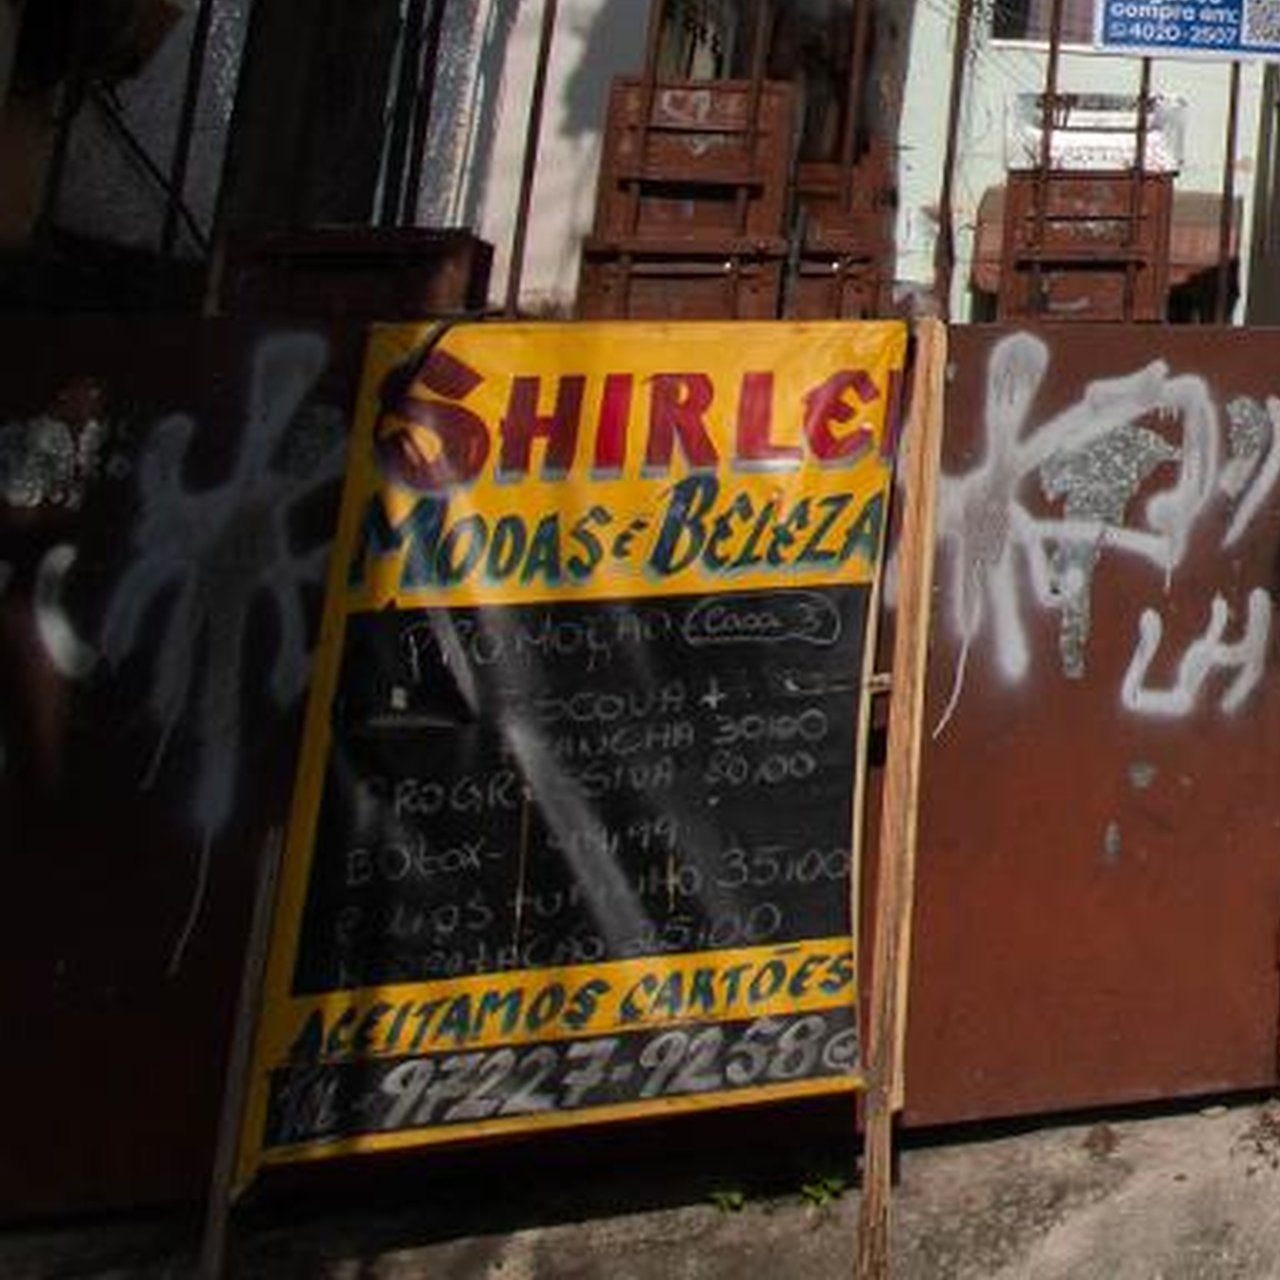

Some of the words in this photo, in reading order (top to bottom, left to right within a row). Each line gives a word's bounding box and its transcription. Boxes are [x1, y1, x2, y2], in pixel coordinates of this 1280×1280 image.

[1110, 2, 1196, 23] compre
[349, 490, 607, 591] MODAS
[640, 474, 888, 581] BELEZA
[289, 978, 610, 1063] ACEITAMOS
[620, 946, 853, 1020] CARTÕES
